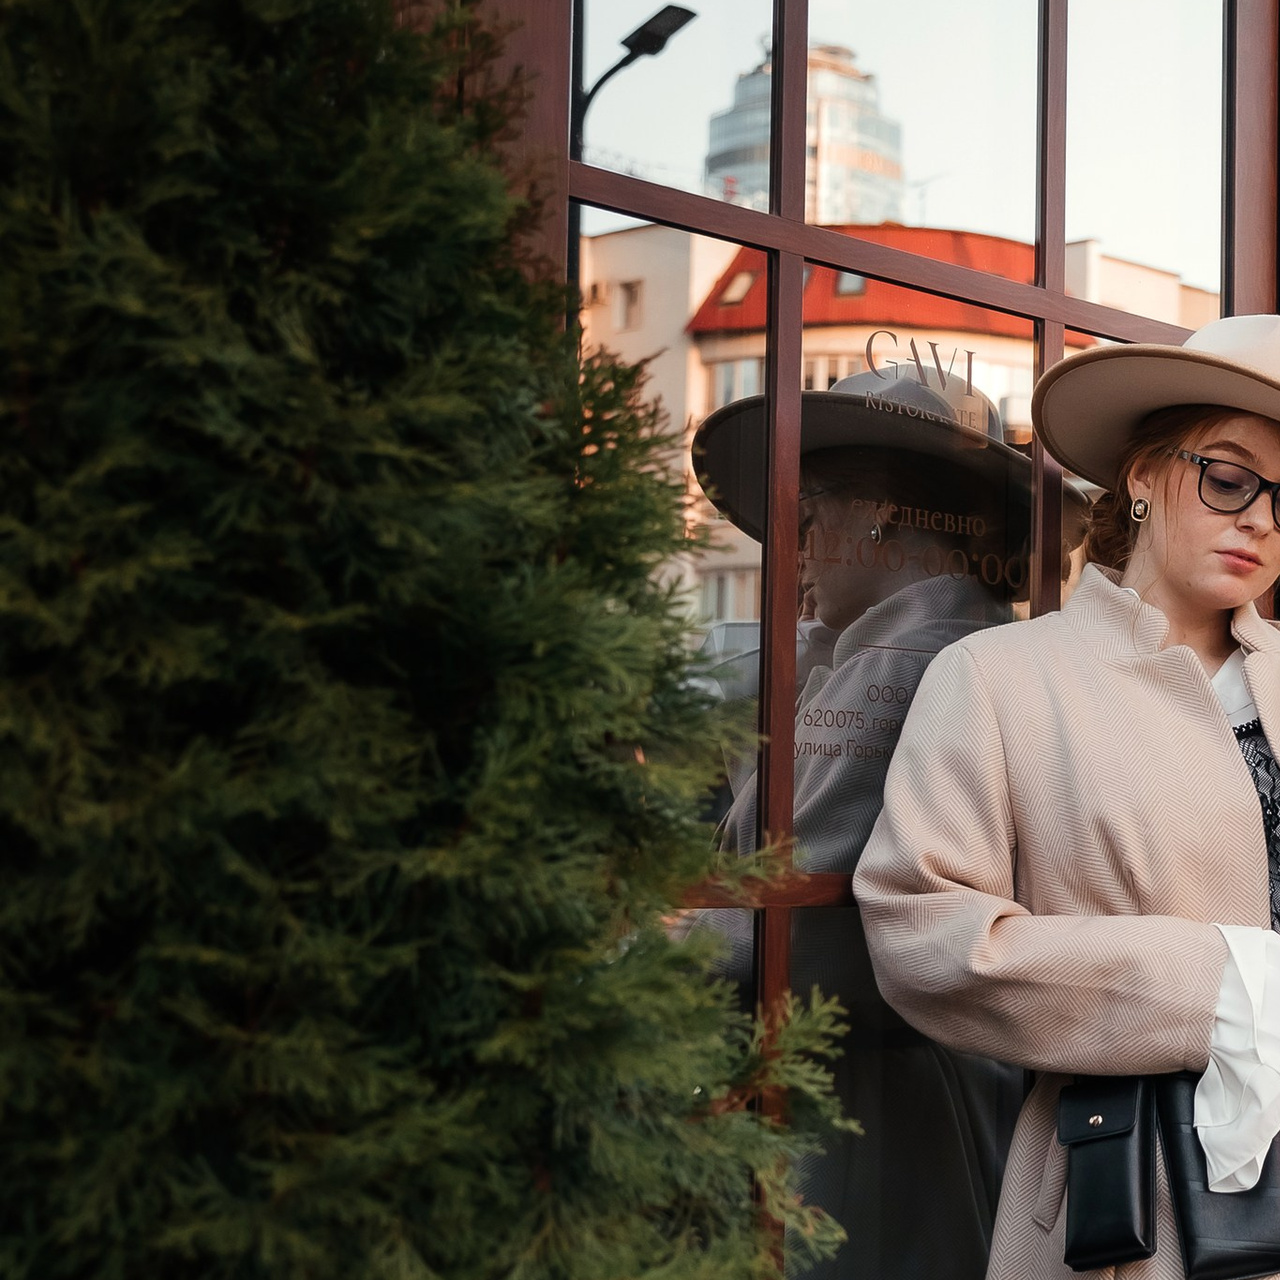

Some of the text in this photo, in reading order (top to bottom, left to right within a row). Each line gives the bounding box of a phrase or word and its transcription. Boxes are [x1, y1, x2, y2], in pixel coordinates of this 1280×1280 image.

[865, 330, 977, 398] GAVI
[851, 496, 986, 537] ежедневно
[804, 527, 1027, 589] 12:00-00:00
[803, 707, 868, 732] 620075,
[794, 739, 894, 762] улица Горьк
